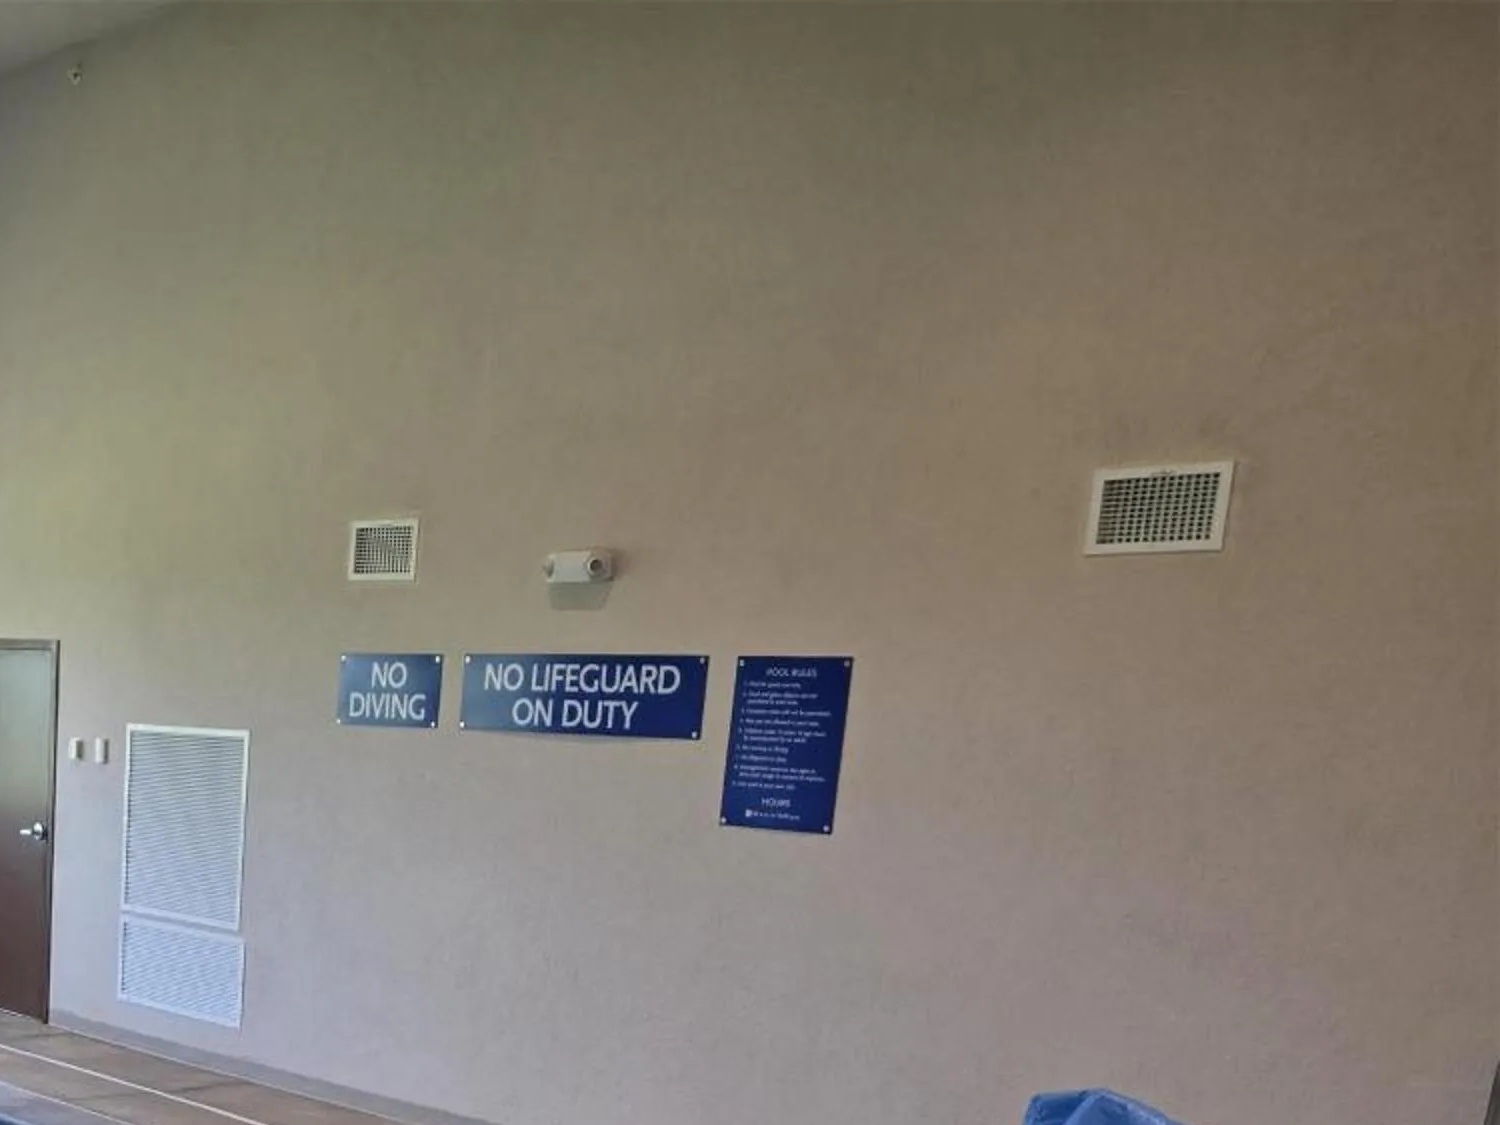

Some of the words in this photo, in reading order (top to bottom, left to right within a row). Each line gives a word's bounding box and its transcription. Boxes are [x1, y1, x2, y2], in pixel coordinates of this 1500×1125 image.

[371, 662, 407, 688] NO
[484, 663, 524, 691] NO
[531, 663, 681, 694] LIFEGUARD
[766, 667, 789, 677] POOL
[791, 667, 818, 678] RULES
[349, 692, 426, 721] DIVING
[512, 698, 553, 727] ON
[561, 699, 639, 730] DUTY
